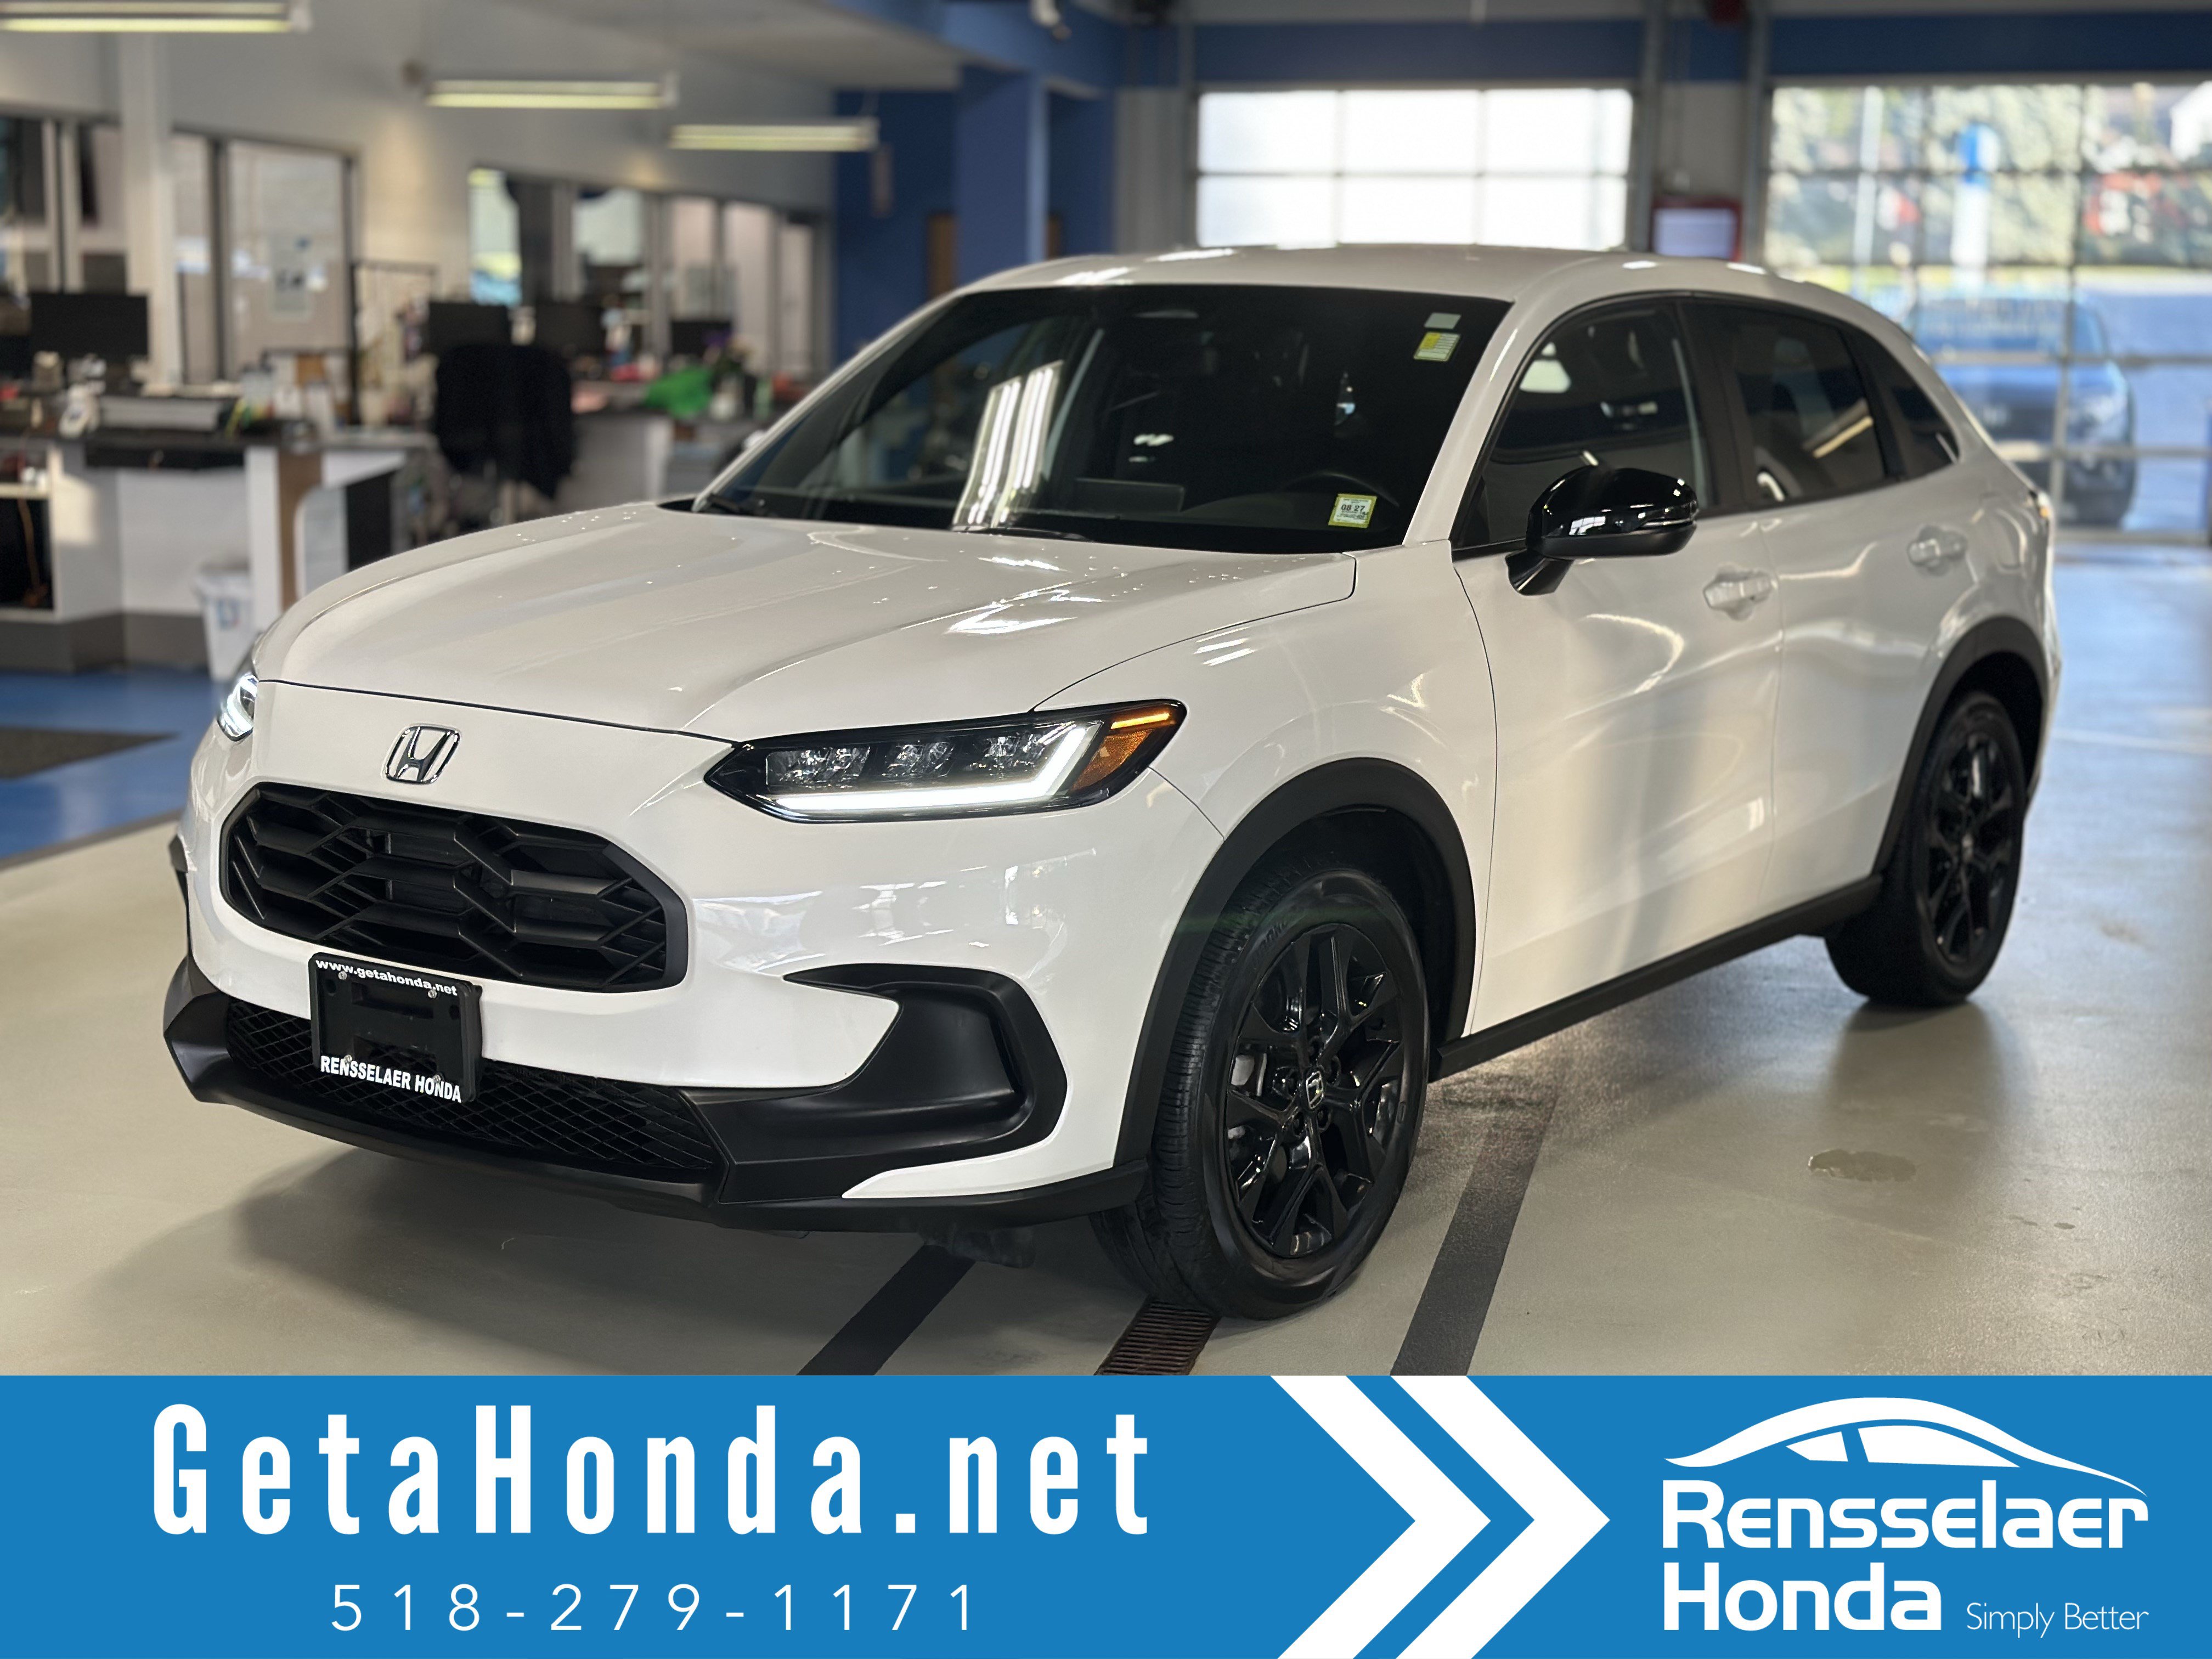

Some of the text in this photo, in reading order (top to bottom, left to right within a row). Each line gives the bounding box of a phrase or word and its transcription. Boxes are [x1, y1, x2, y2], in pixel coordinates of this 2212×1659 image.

[315, 960, 458, 996] www.getahonda.net
[320, 1055, 462, 1104] RENSSELAER HONDA
